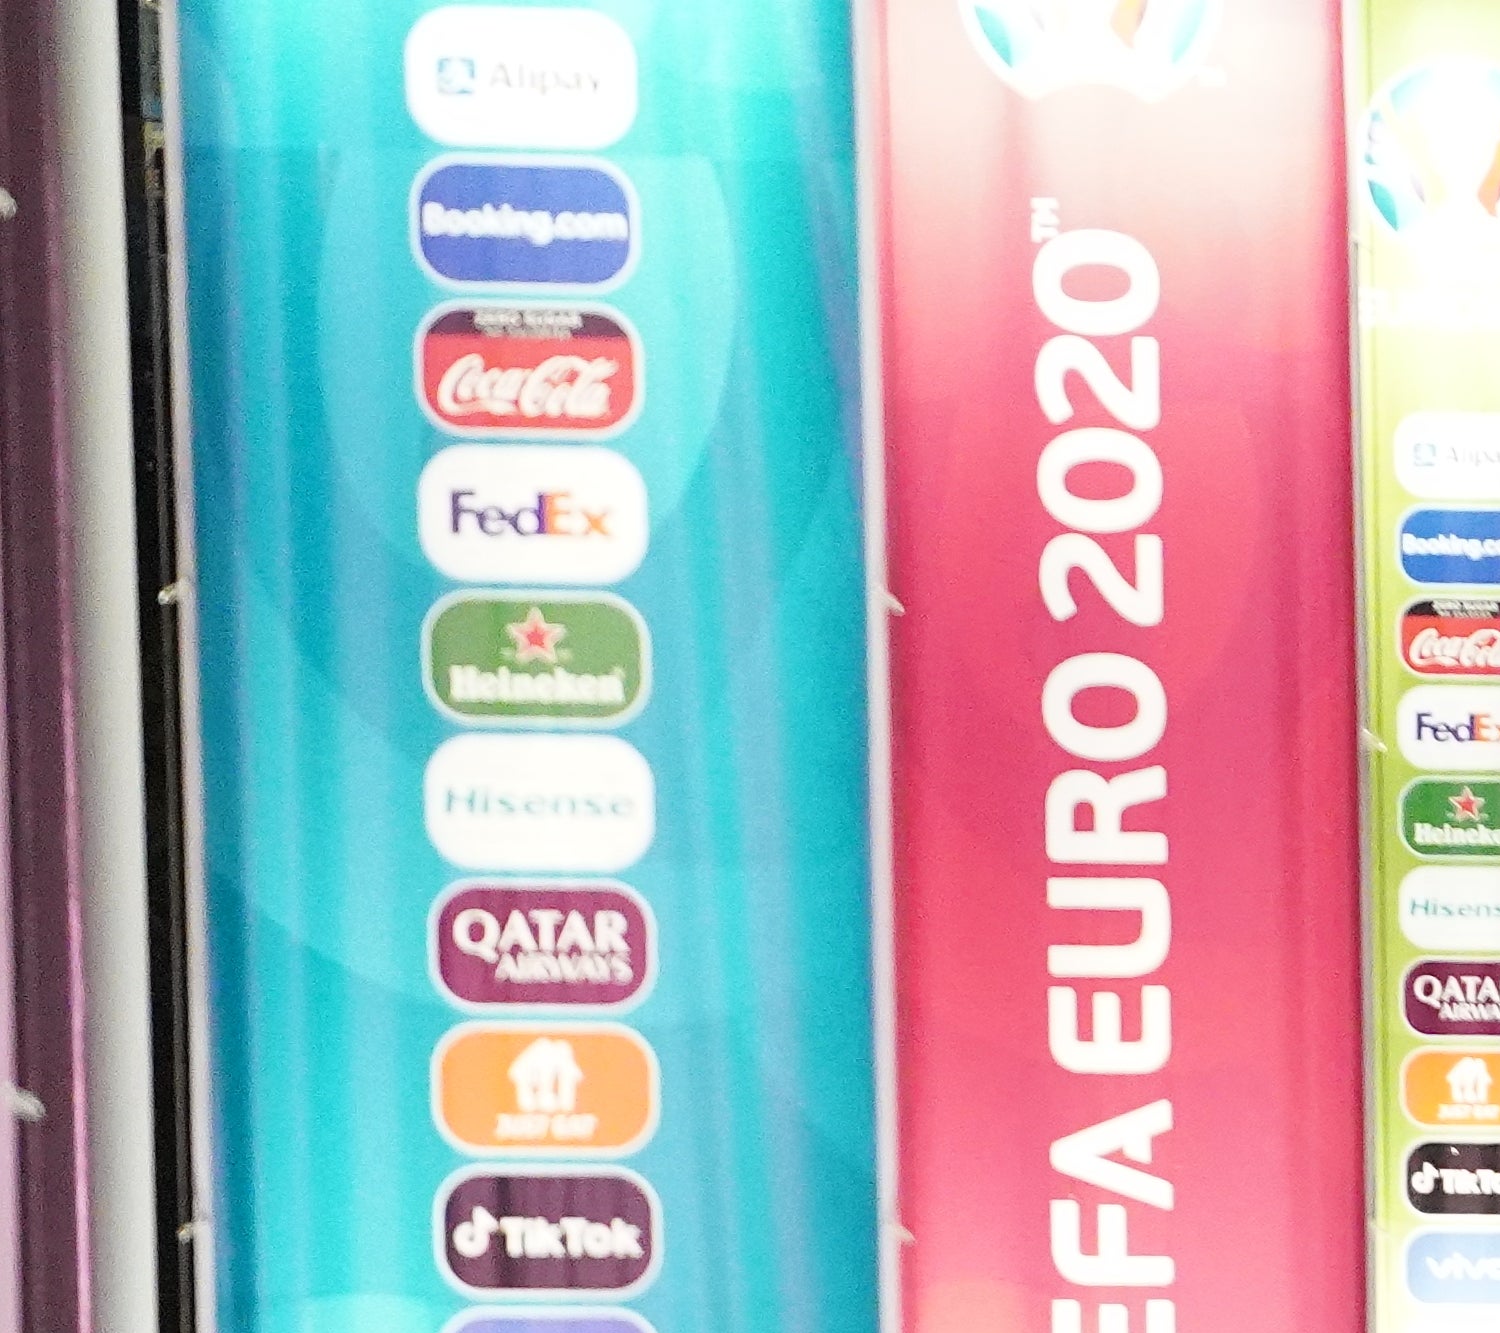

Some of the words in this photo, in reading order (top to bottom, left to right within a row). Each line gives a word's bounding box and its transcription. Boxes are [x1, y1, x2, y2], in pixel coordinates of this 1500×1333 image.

[421, 200, 629, 246] Booking.com
[1032, 228, 1164, 627] 2020
[450, 488, 614, 537] FedEx
[449, 664, 626, 704] Heineken
[444, 783, 634, 817] Hisense
[1041, 652, 1173, 1075] EURO
[452, 907, 632, 963] QATAR
[494, 952, 635, 985] AIRWAYS
[501, 1214, 646, 1259] TikTok
